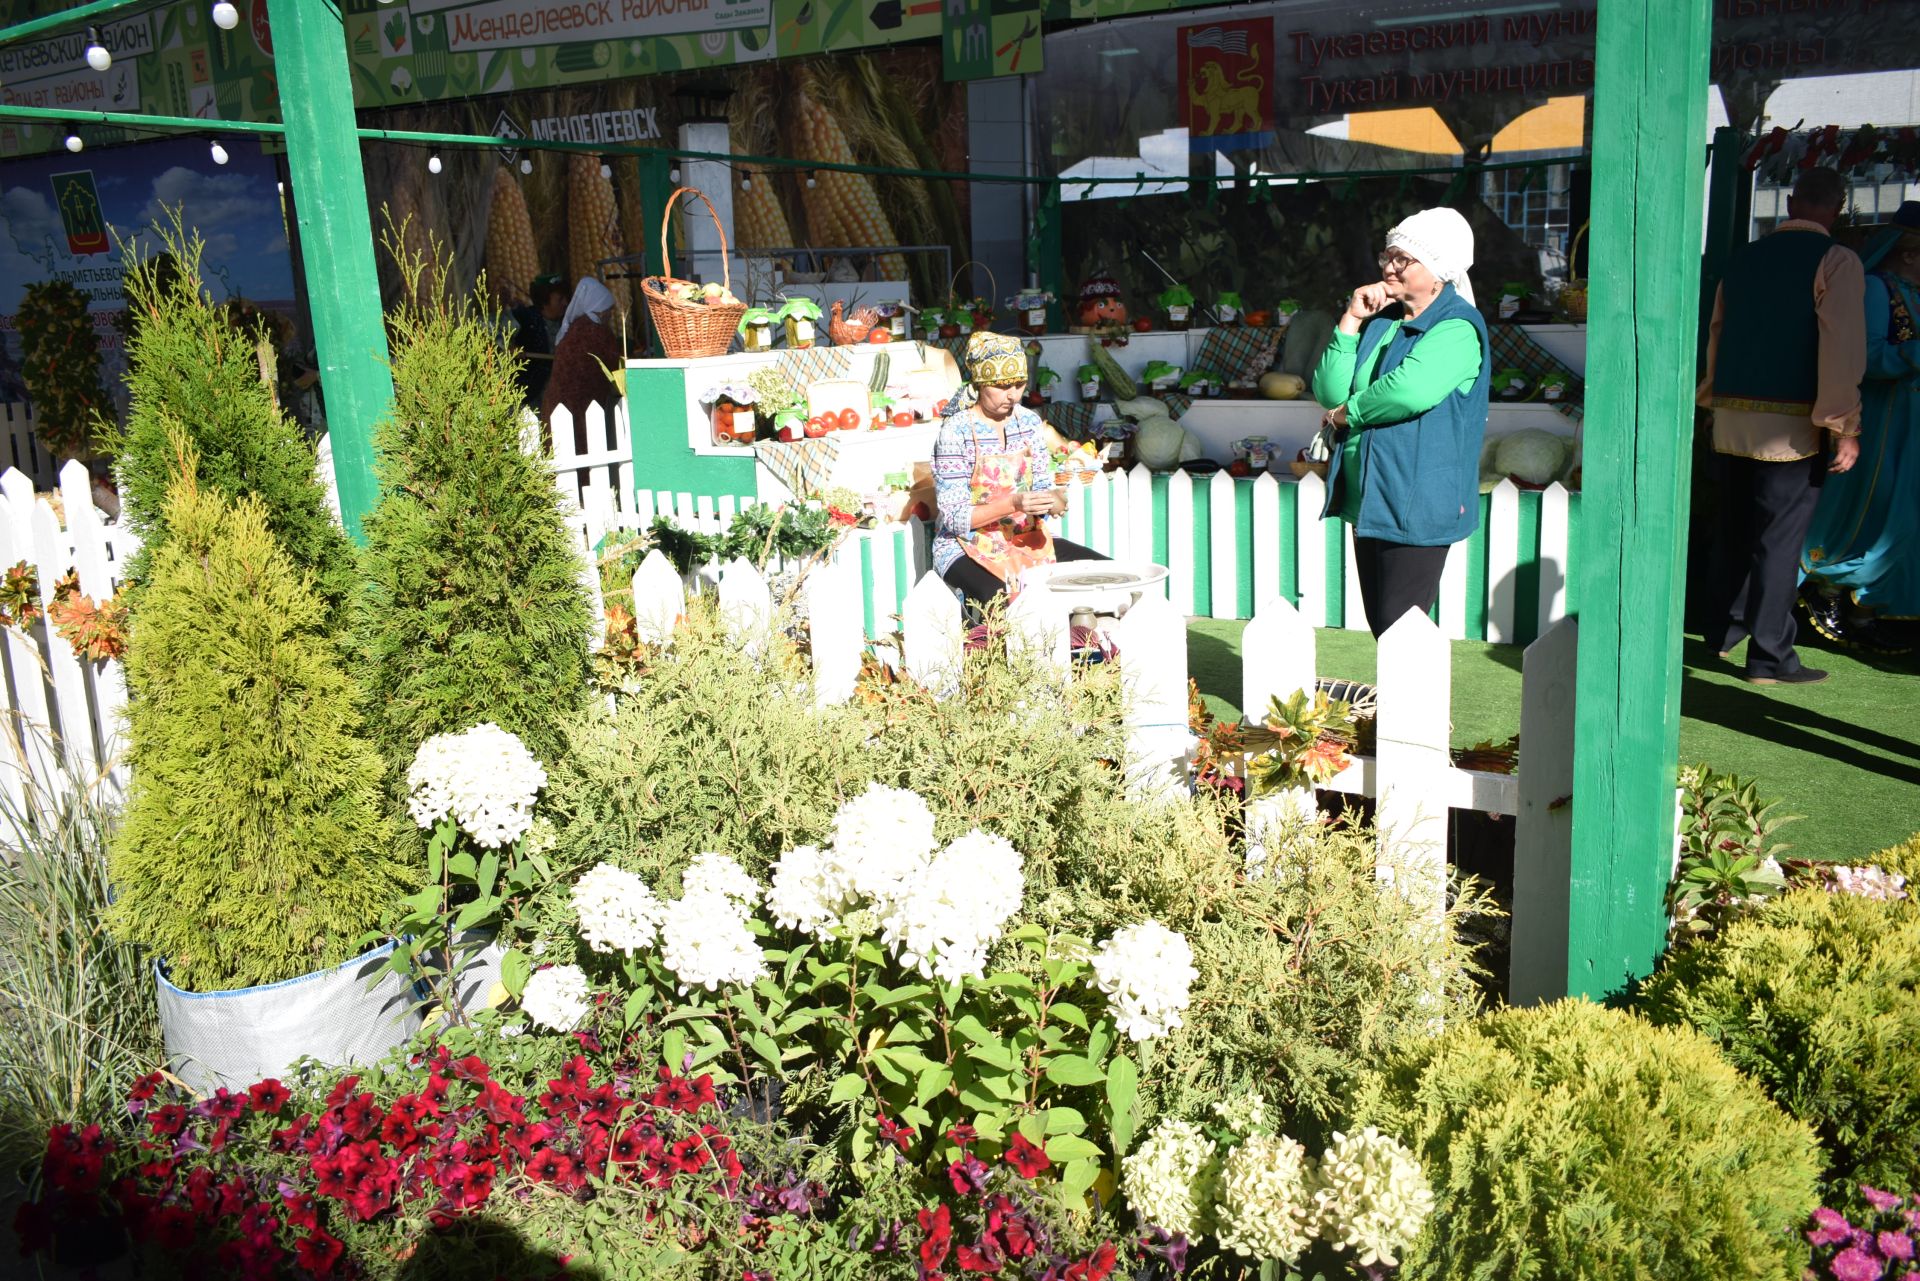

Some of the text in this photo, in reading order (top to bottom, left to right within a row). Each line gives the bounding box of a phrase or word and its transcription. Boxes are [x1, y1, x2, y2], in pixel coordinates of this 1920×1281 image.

[104, 23, 149, 52] айон
[451, 0, 613, 46] Менделеевск
[1288, 15, 1490, 68] Тукаевский
[1299, 68, 1398, 113] Тукай
[531, 107, 662, 144] МЕНДЕЛЕЕВСК
